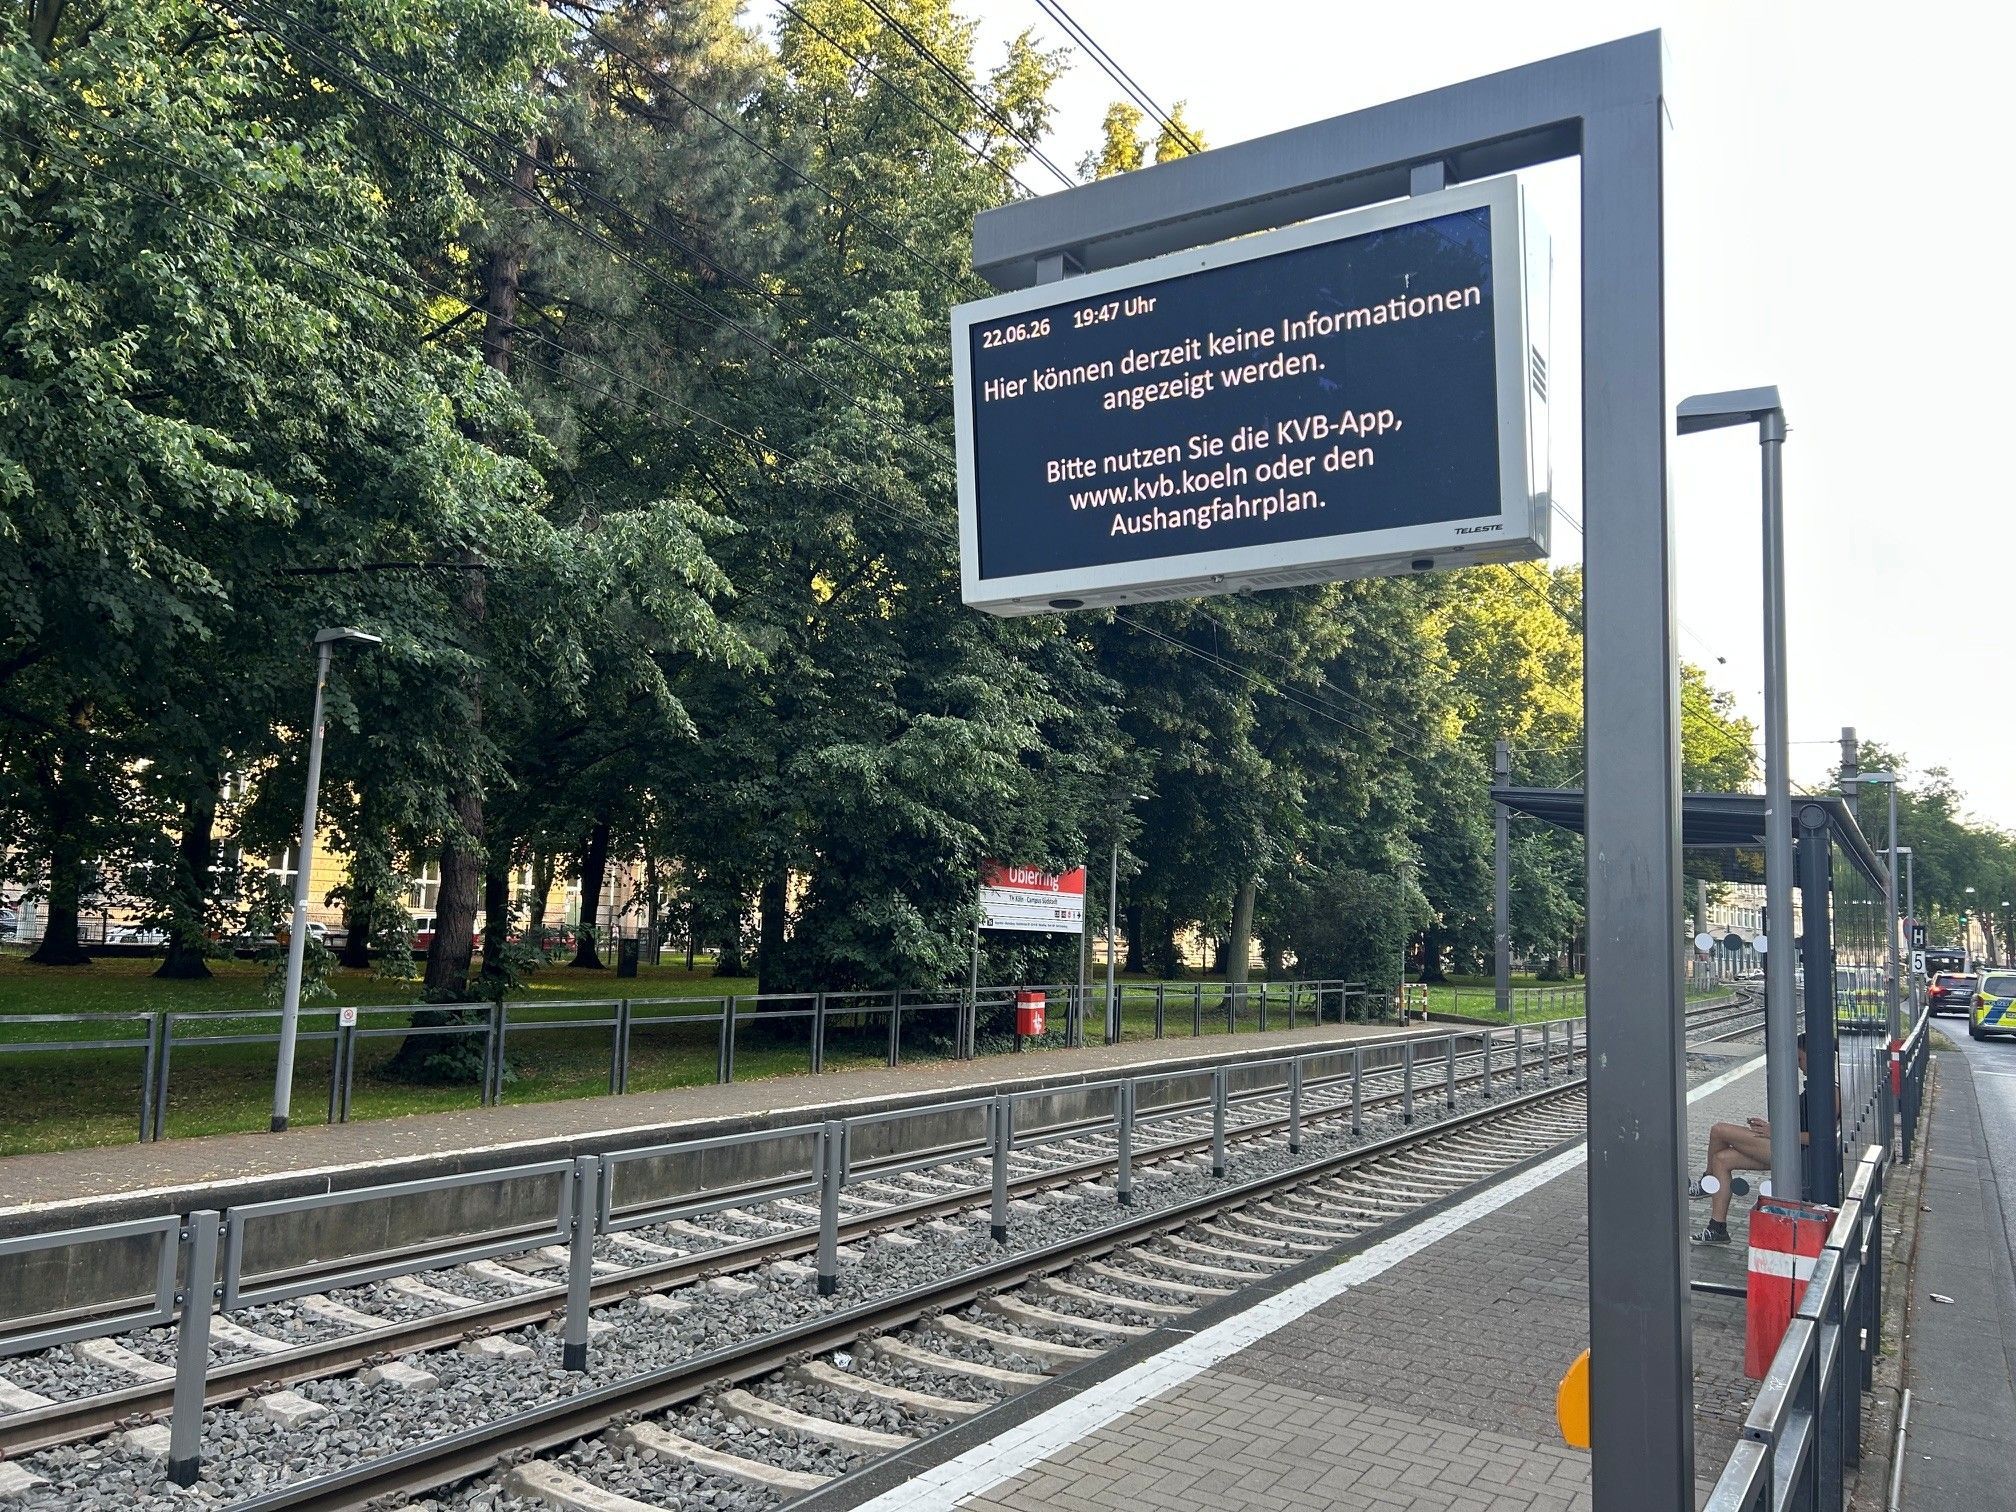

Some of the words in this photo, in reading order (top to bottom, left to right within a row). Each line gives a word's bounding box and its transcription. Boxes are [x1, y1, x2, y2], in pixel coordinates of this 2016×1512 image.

[983, 318, 1050, 348] 22.06.26
[1073, 302, 1119, 329] 19:47
[1124, 296, 1157, 316] Uhr
[984, 376, 1028, 402] Hier
[1033, 360, 1113, 392] können
[1120, 338, 1202, 375] derzeit
[1209, 328, 1275, 357] keine
[1283, 285, 1481, 342] Informationen
[1103, 369, 1214, 410] angezeigt
[1221, 352, 1326, 387] werden.
[1046, 457, 1097, 483] Bitte
[1104, 444, 1181, 474] nutzen
[1188, 434, 1224, 460] Sie
[1231, 426, 1269, 453] die
[1277, 408, 1403, 445] KVB-App,
[1069, 462, 1247, 511] www.kvb.koeln
[1255, 454, 1315, 482] oder
[1323, 446, 1374, 472] den
[1111, 488, 1326, 537] Aushangfahrplan.
[1454, 524, 1503, 535] TELESTE
[1009, 867, 1059, 891] Ubierring
[1913, 929, 1924, 945] H
[1914, 953, 1923, 970] 5
